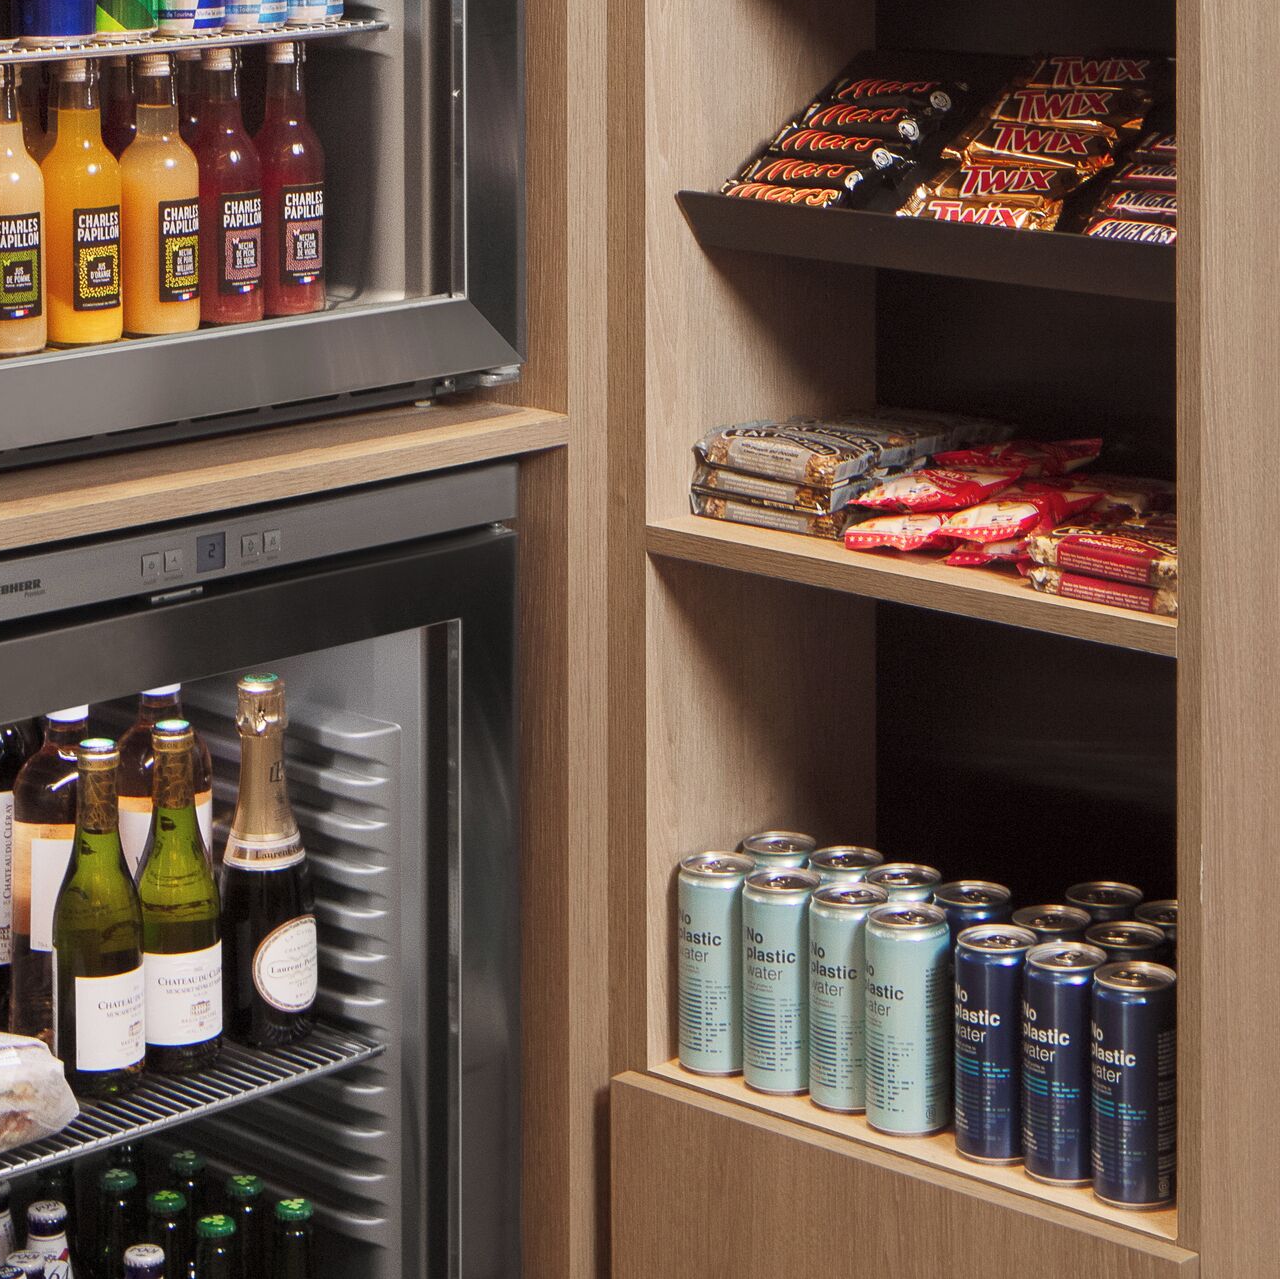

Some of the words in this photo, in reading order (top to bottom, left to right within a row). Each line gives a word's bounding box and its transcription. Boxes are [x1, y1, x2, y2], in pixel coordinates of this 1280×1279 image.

[838, 79, 941, 99] Mars
[809, 104, 908, 128] Mars
[782, 129, 882, 152] Mars
[754, 158, 855, 181] Mars
[285, 191, 322, 206] CHARLES
[726, 182, 838, 206] Mars
[164, 205, 198, 221] CHARLES
[224, 198, 261, 214] CHARLES
[284, 204, 323, 220] PAPILLON
[79, 212, 118, 228] CHARLES
[223, 211, 262, 228] PAPILLON
[77, 225, 119, 242] PAPILLON
[14, 267, 24, 275] JUS
[208, 542, 217, 559] 2
[746, 927, 763, 944] No
[746, 946, 796, 964] plastic
[158, 976, 195, 986] CHATEAU
[98, 996, 132, 1010] CHATEAU
